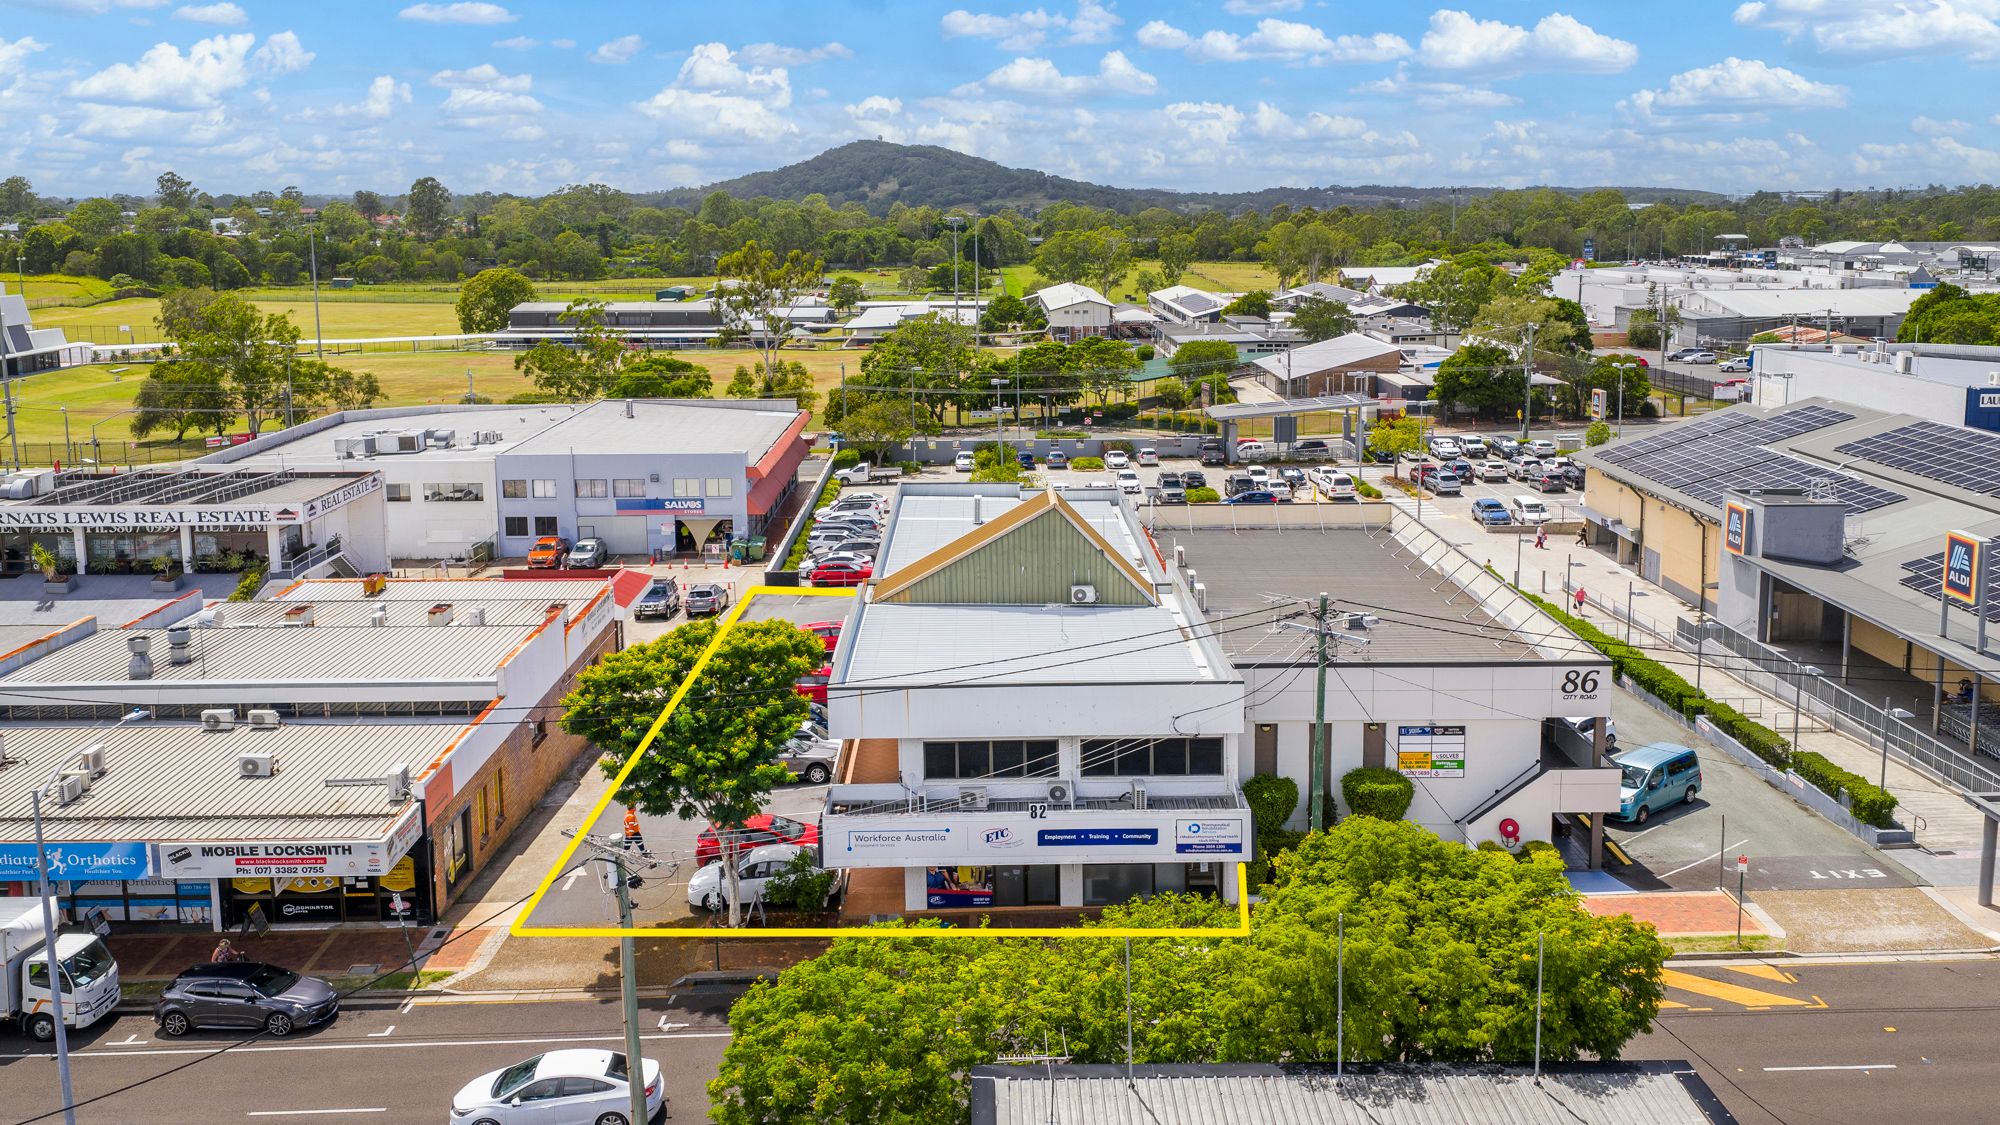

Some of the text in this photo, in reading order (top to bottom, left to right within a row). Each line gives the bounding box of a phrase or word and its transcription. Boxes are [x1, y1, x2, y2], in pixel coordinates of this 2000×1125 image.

[1981, 396, 2000, 405] LAU
[321, 480, 370, 511] REAL ESTATE
[664, 500, 702, 509] SALVOS
[63, 511, 128, 524] LEWIS
[134, 511, 192, 524] REAL
[197, 510, 272, 523] ESTATE
[1728, 533, 1741, 546] ALDI
[1948, 570, 1970, 587] ALDI
[1561, 670, 1600, 693] 86
[1030, 804, 1047, 819] 82
[854, 833, 947, 842] Workforce Australia
[986, 828, 1009, 843] ETC
[201, 845, 352, 857] MOBILE LOCKSMITH
[67, 854, 137, 866] Orthotics
[254, 867, 272, 875] (07)
[1809, 868, 1888, 879] EXIT
